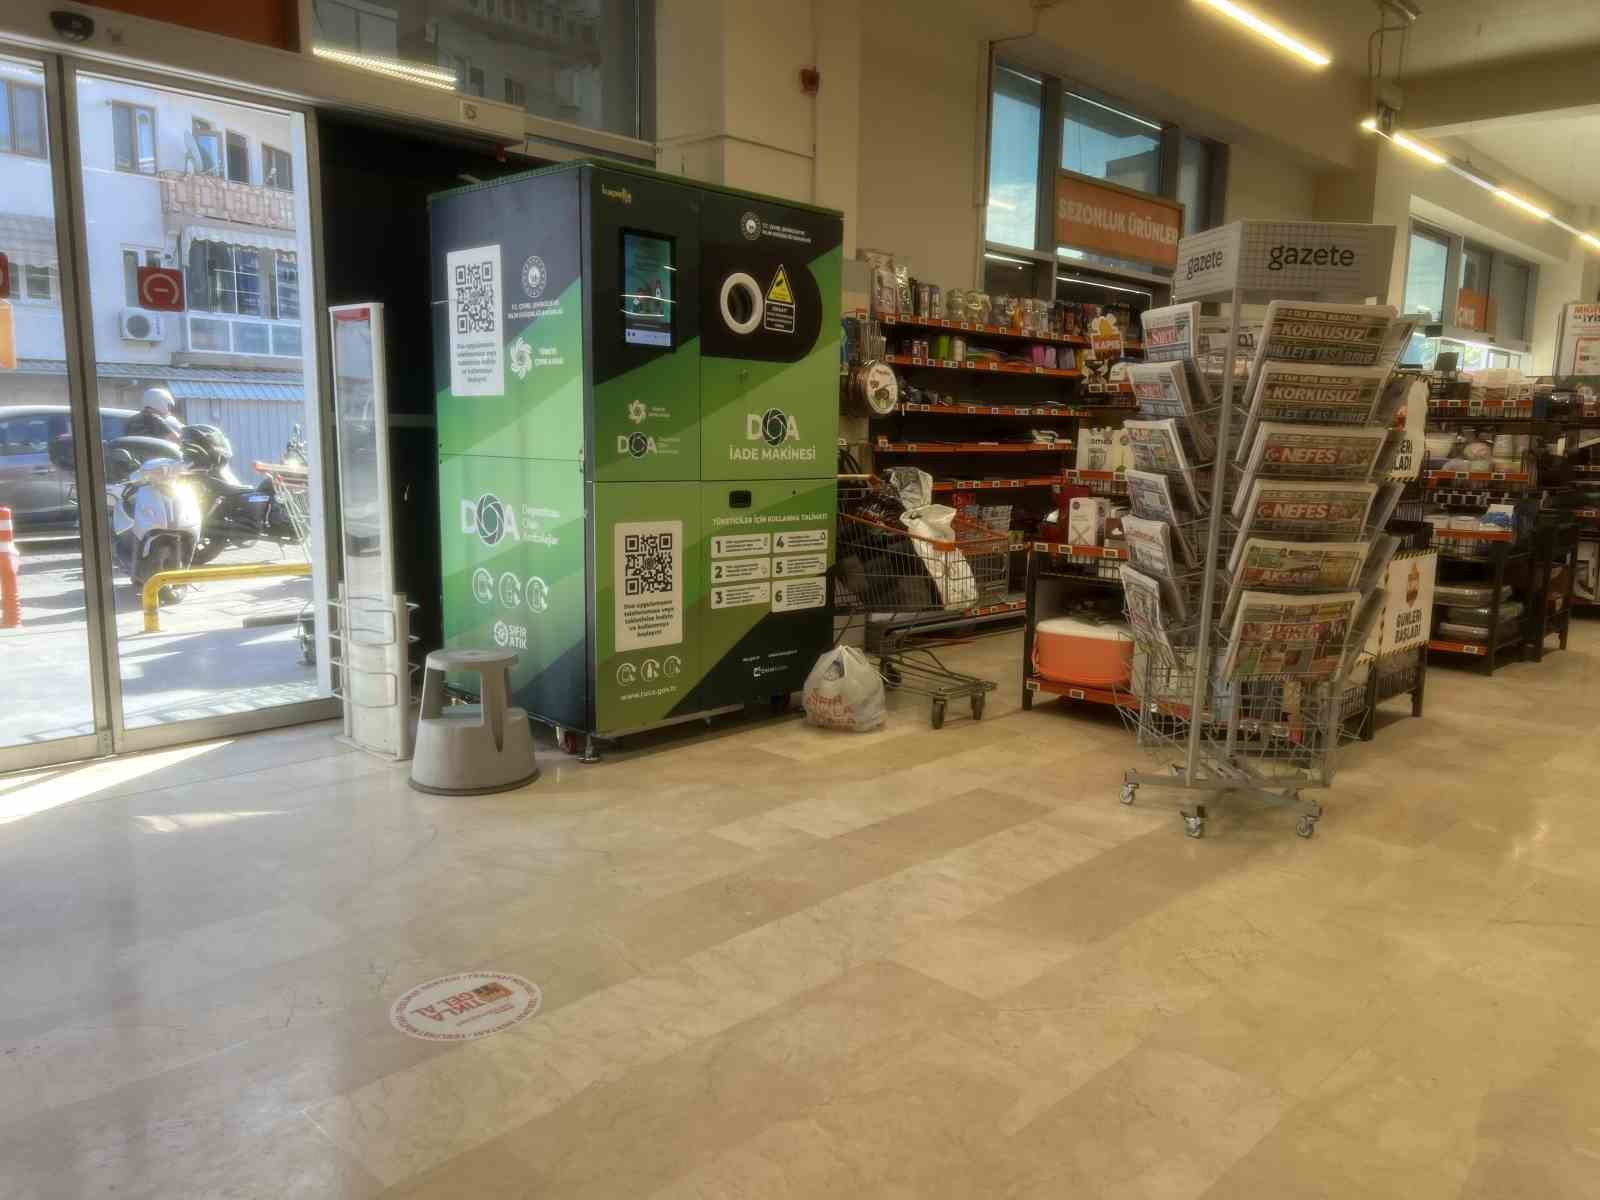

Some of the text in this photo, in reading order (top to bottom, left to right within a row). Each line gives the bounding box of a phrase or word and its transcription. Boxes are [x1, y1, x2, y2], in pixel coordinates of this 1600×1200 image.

[1058, 198, 1126, 233] SEZONLUK
[1267, 243, 1355, 271] gazete
[1187, 249, 1224, 280] gazete
[1282, 322, 1365, 341] KORKUSUZ
[1273, 385, 1358, 401] KORKUSUZ
[729, 443, 816, 461] İADE MAKİNESİ
[1281, 448, 1338, 463] NEFES
[1273, 504, 1329, 518] NEFES
[716, 541, 721, 553] 1
[776, 536, 784, 548] 4
[715, 566, 722, 578] 2
[776, 562, 782, 574] 5
[715, 592, 722, 604] 3
[775, 590, 782, 602] 6
